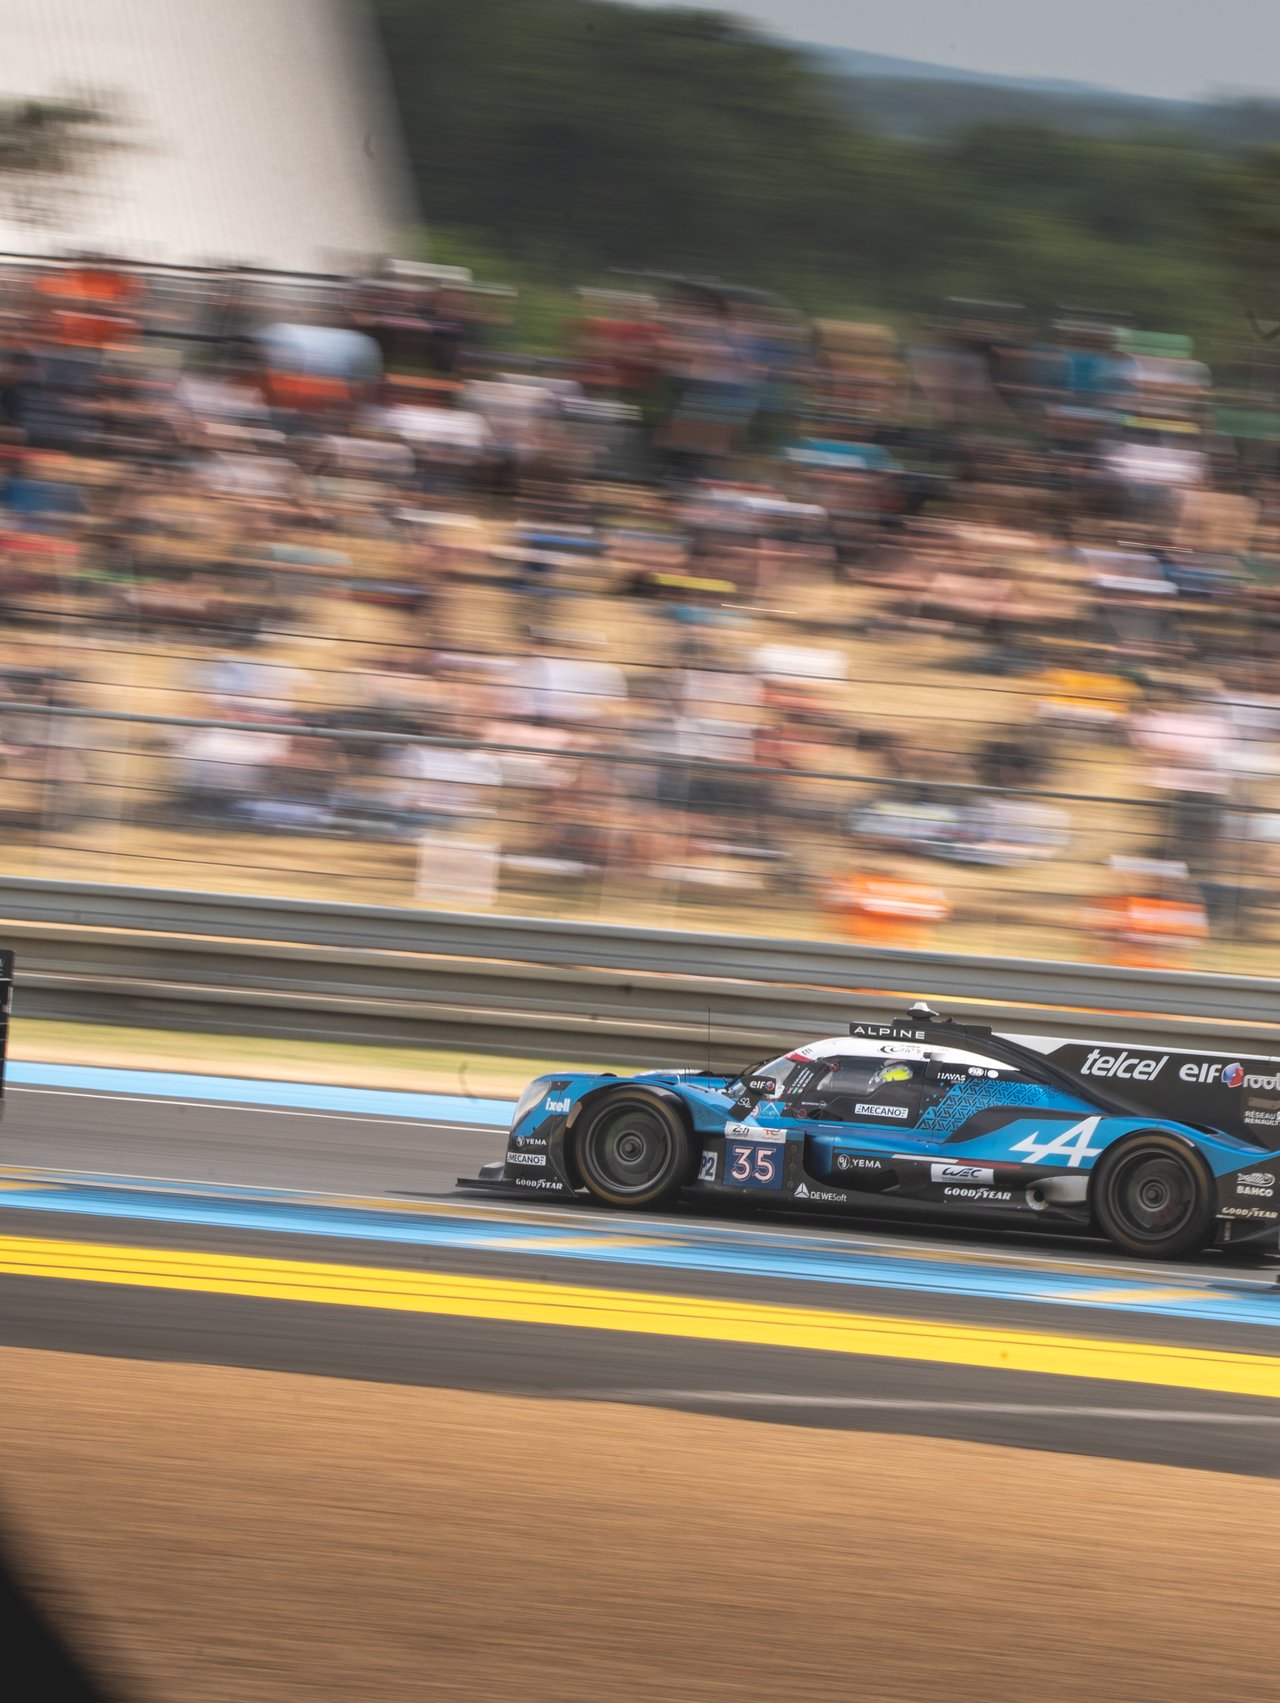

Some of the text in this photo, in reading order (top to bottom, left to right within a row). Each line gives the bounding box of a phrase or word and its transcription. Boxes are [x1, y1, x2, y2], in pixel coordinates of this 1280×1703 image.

[854, 1026, 926, 1040] ALPINE
[1080, 1049, 1170, 1081] telcel
[1179, 1062, 1222, 1084] elf
[749, 1080, 766, 1089] elf
[545, 1097, 571, 1113] ixell
[860, 1105, 902, 1117] MECANO
[526, 1138, 547, 1146] YEMA
[731, 1144, 777, 1183] 35
[852, 1158, 882, 1169] YEMA
[942, 1167, 982, 1179] WEC
[515, 1178, 563, 1190] GOODYEAR
[944, 1187, 1012, 1201] GOODYEAR
[1236, 1185, 1274, 1197] BAHCO
[1221, 1207, 1279, 1219] GOODYEAR
